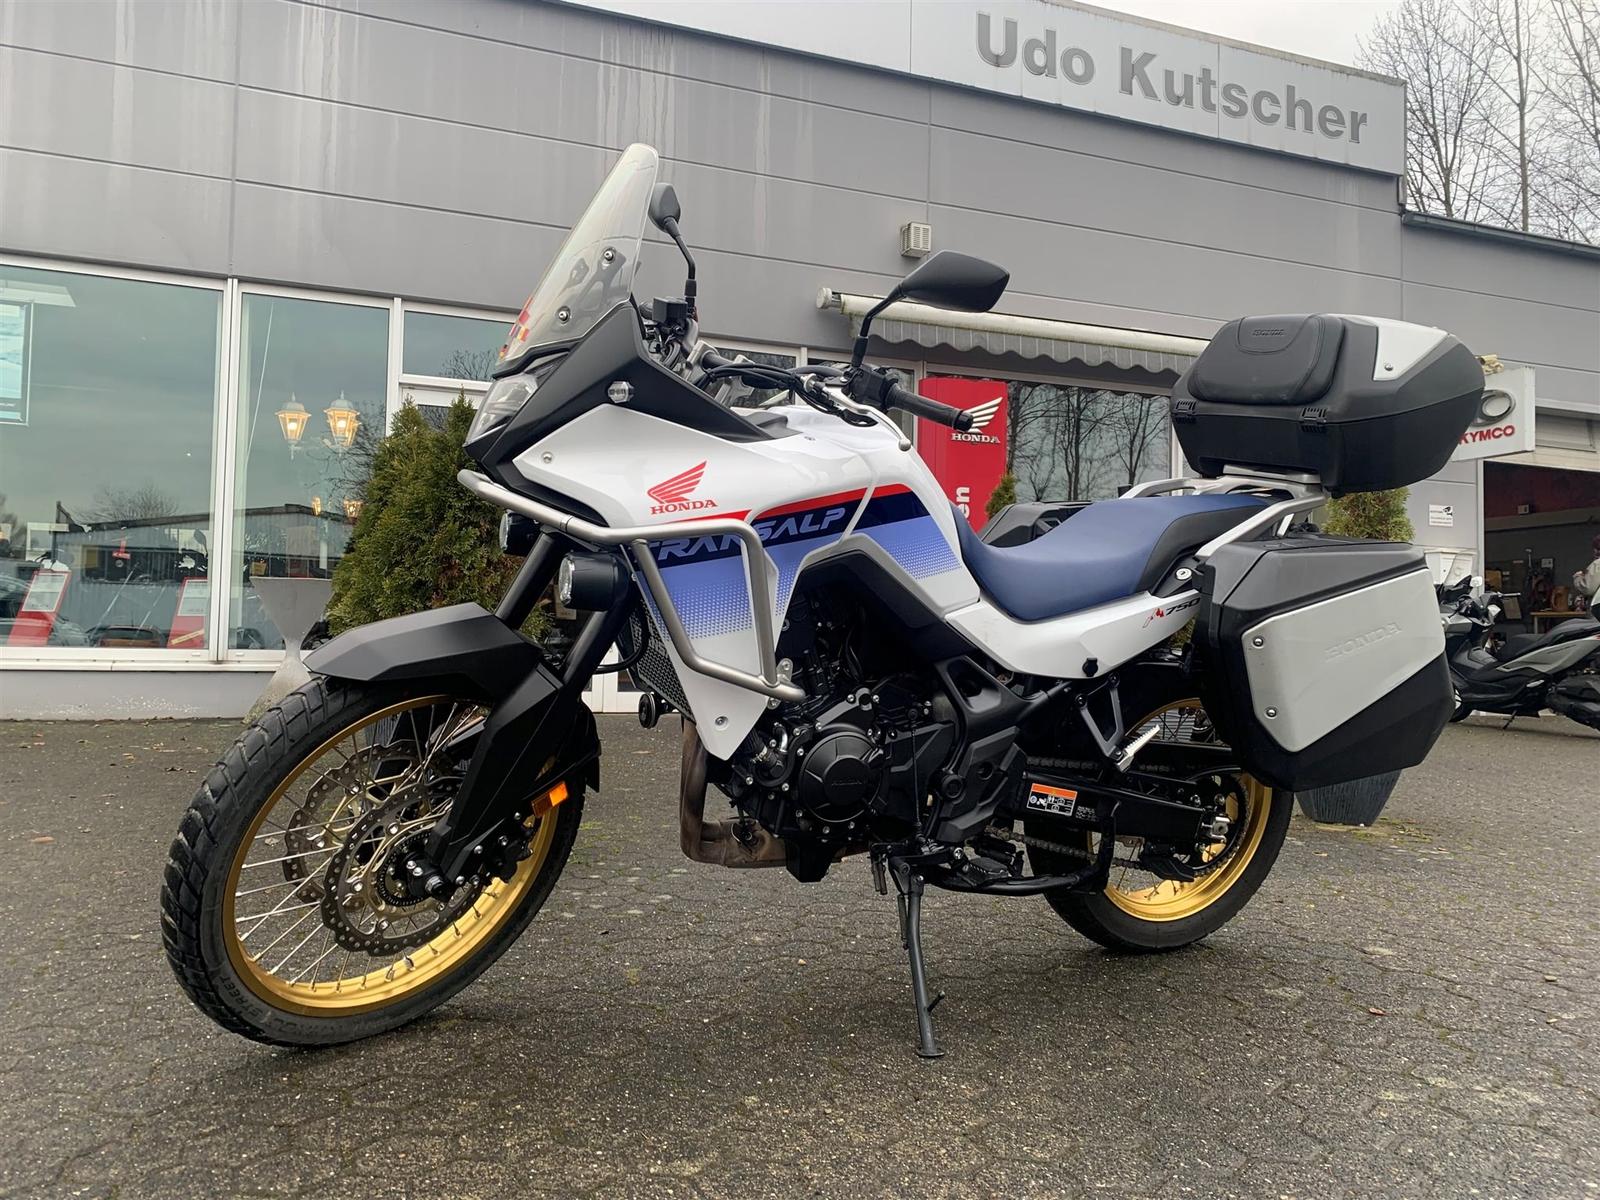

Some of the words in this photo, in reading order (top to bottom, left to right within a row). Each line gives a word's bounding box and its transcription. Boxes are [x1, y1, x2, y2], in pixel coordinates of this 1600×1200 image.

[976, 11, 1096, 85] Udo
[1119, 46, 1369, 144] Kutscher
[951, 432, 1001, 444] HONDA
[1459, 425, 1516, 445] KYMCO
[650, 499, 718, 515] HONDA
[650, 507, 846, 561] RANSALP
[1166, 597, 1201, 616] 750
[1324, 621, 1402, 662] HONDA
